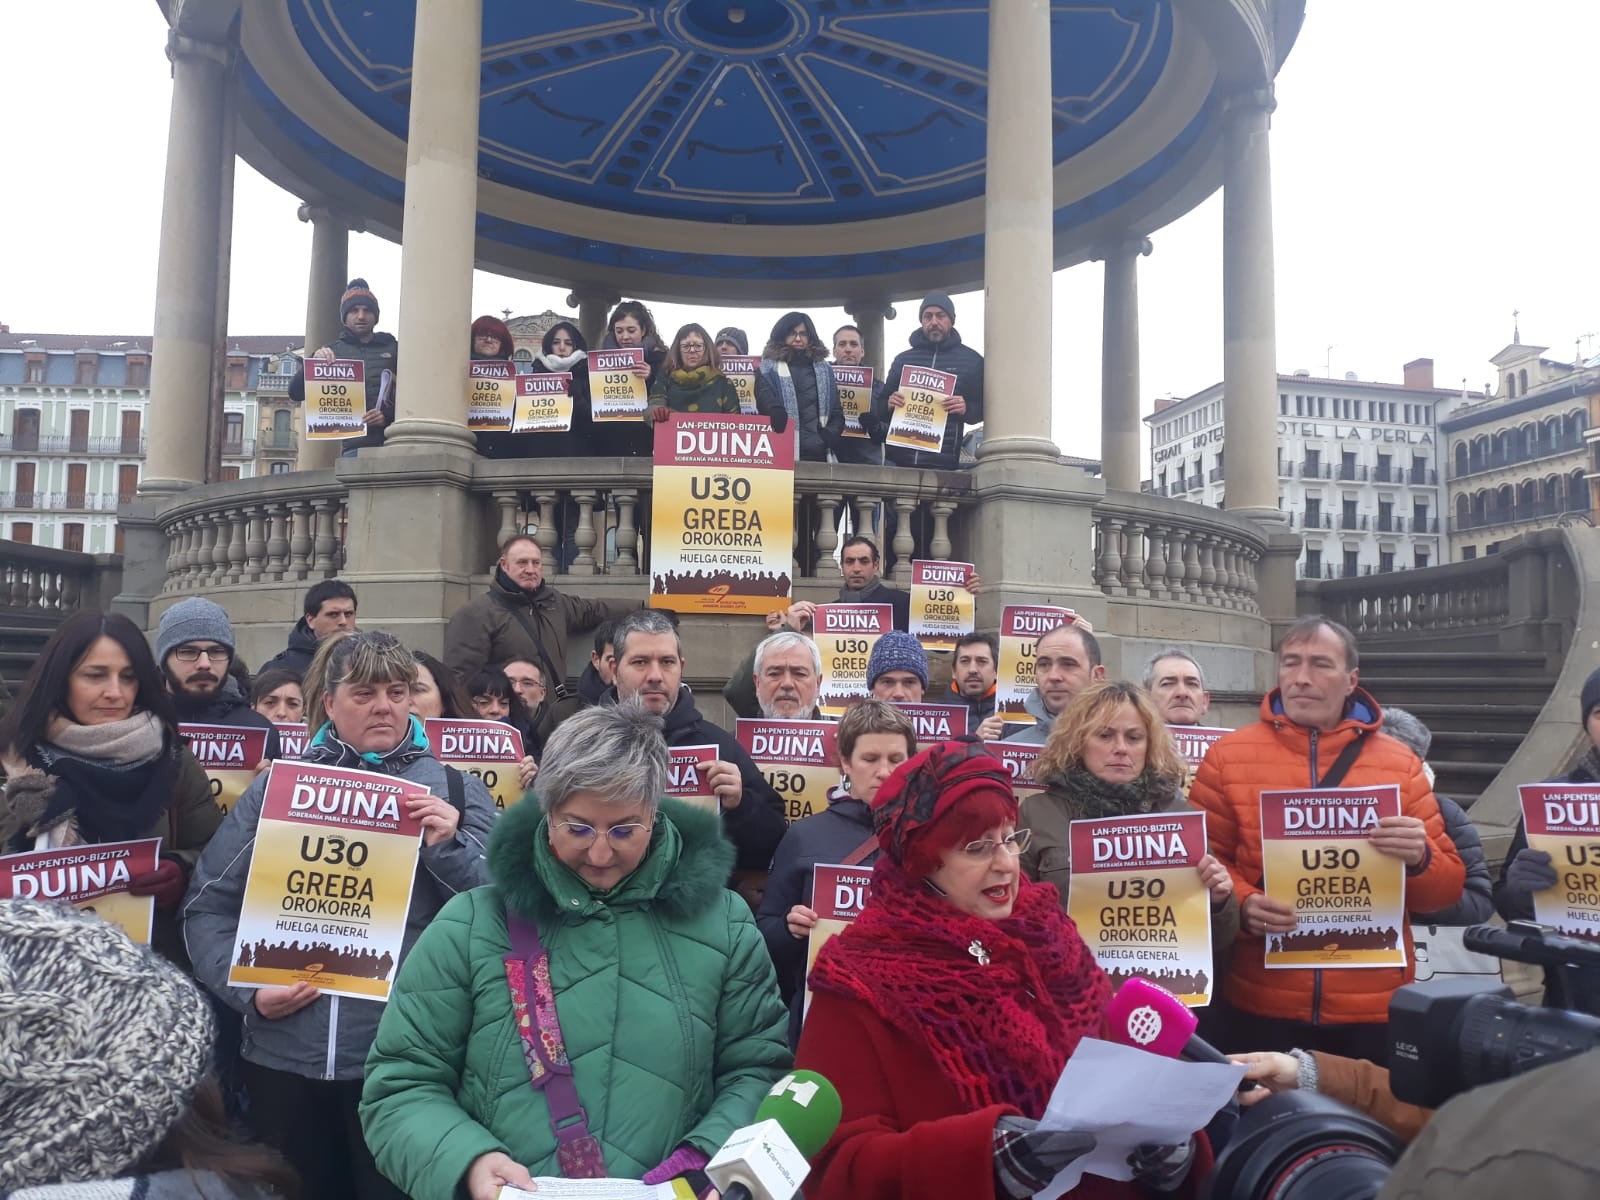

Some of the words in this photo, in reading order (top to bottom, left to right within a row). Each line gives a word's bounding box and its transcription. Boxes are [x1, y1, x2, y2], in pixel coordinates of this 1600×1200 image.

[598, 356, 634, 367] DUINA
[314, 367, 355, 377] DUINA
[472, 366, 509, 376] DUINA
[605, 375, 628, 383] U30
[733, 379, 746, 387] 30
[909, 374, 944, 389] DUINA
[321, 386, 346, 395] U30
[476, 382, 499, 390] U30
[525, 381, 564, 391] DUINA
[604, 386, 634, 394] GREBA
[472, 393, 501, 401] GREBA
[839, 390, 855, 399] 30
[911, 392, 934, 403] U30
[319, 398, 352, 406] GREBA
[532, 399, 555, 407] U30
[840, 402, 858, 410] EBA
[907, 404, 934, 416] GREBA
[676, 422, 772, 432] LAN-PENTSIO-BIZITZA
[1276, 422, 1324, 437] OTEL
[1335, 425, 1361, 440] LA
[1371, 428, 1433, 445] PERLA
[676, 431, 774, 457] DUINA
[1154, 443, 1182, 462] GRAN
[691, 477, 751, 501] U30
[684, 508, 762, 531] GREBA
[683, 532, 762, 546] OROKORRA
[680, 554, 717, 564] HUELGA
[720, 554, 763, 564] GENERAL
[922, 570, 964, 582] DUINA
[929, 590, 954, 601] U30
[925, 604, 960, 615] GREBA
[826, 614, 880, 628] DUINA
[836, 640, 868, 653] U30
[832, 657, 867, 670] GREB
[754, 728, 824, 736] LAN-PENTSIO-BIZITZA
[912, 717, 951, 736] INA
[180, 732, 245, 740] PENTSIO-BIZITZA
[193, 741, 244, 760] INA
[442, 735, 515, 754] DUINA
[752, 735, 824, 757] DUINA
[296, 774, 403, 794] LAN-PENTSIO-BIZITZA
[291, 784, 400, 821] DUINA
[350, 818, 375, 827] CAMBIO
[376, 821, 398, 829] SOCIAL
[1284, 807, 1379, 829] DUINA
[1092, 823, 1183, 836] LAN-PENTSIO-BIZITZA
[301, 836, 368, 866] U30
[1093, 833, 1188, 862] DUINA
[11, 849, 130, 872] LAN-PENTSIO-BIZITZA
[1302, 849, 1360, 870] U30
[12, 860, 130, 899] DUINA
[287, 870, 374, 901] GREBA
[1108, 878, 1165, 900] U30
[1297, 877, 1371, 896] GREBA
[282, 896, 371, 919] OROKORRA
[1296, 896, 1372, 909] OROKORRA
[1100, 906, 1177, 927] GREBA
[1332, 914, 1372, 923] GENERAL
[276, 920, 319, 933] HUELGA
[322, 924, 368, 939] GENERAL
[1100, 929, 1178, 942] OROKORRA
[1098, 950, 1134, 959] HUELGA
[1136, 950, 1180, 960] GENERAL
